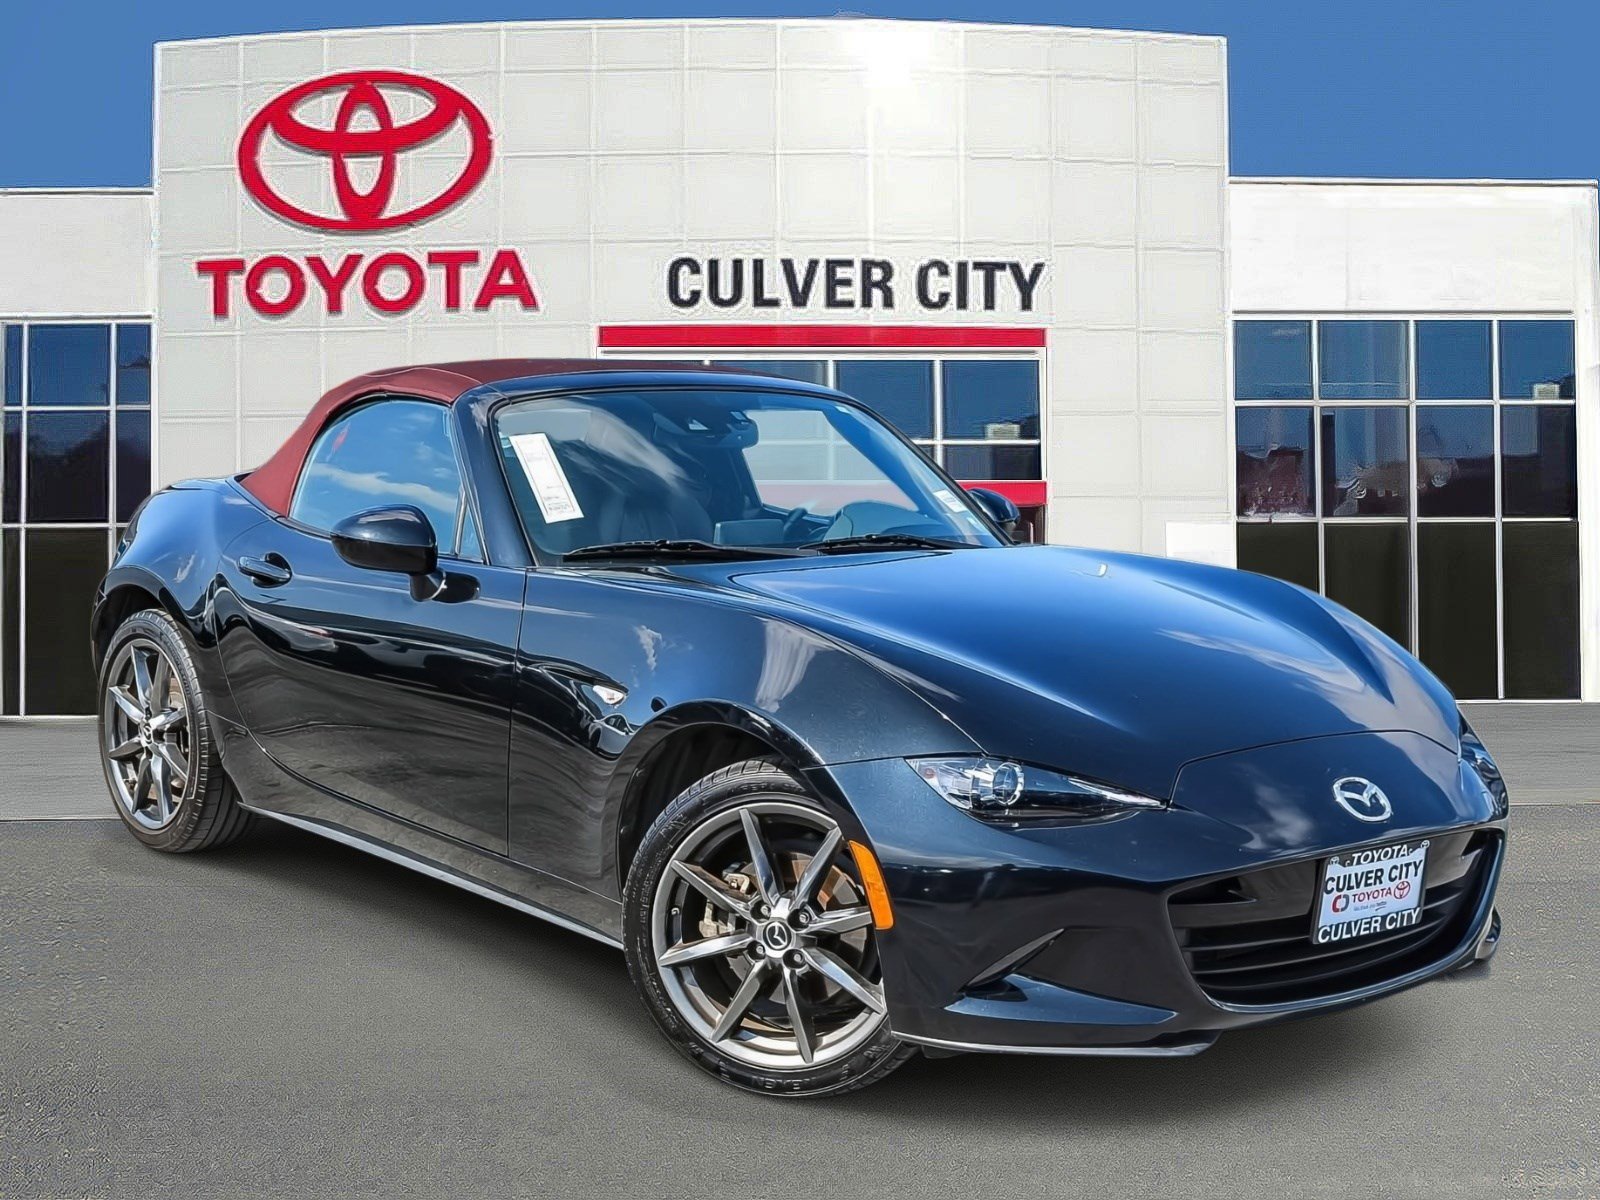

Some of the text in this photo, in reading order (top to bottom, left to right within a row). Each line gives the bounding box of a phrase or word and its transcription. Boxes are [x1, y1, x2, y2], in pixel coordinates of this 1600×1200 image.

[195, 249, 539, 318] TOYOTA
[668, 257, 1045, 311] CULVER CITY
[1352, 844, 1408, 866] TOYOTA
[1324, 859, 1423, 894] CULVER CITY
[1352, 887, 1392, 903] TOYOTA
[1318, 907, 1420, 943] CULVER CITY
